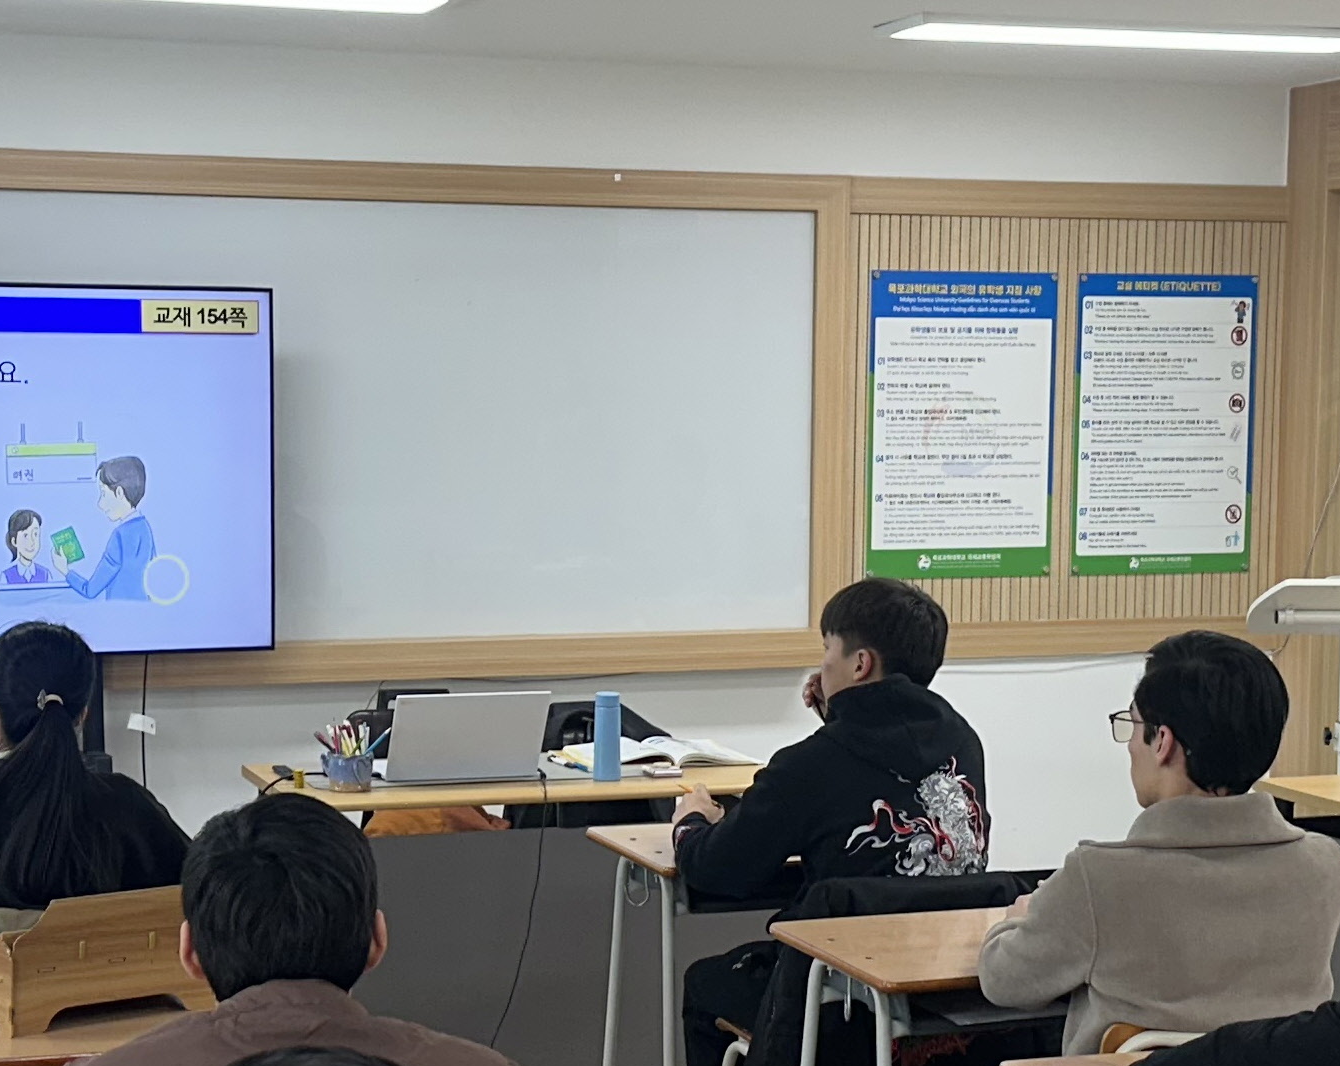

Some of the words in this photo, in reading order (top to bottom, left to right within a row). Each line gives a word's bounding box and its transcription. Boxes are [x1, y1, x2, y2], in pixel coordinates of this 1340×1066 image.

[153, 306, 191, 328] 교재
[197, 307, 248, 328] 154쪽
[13, 468, 34, 482] 여권
